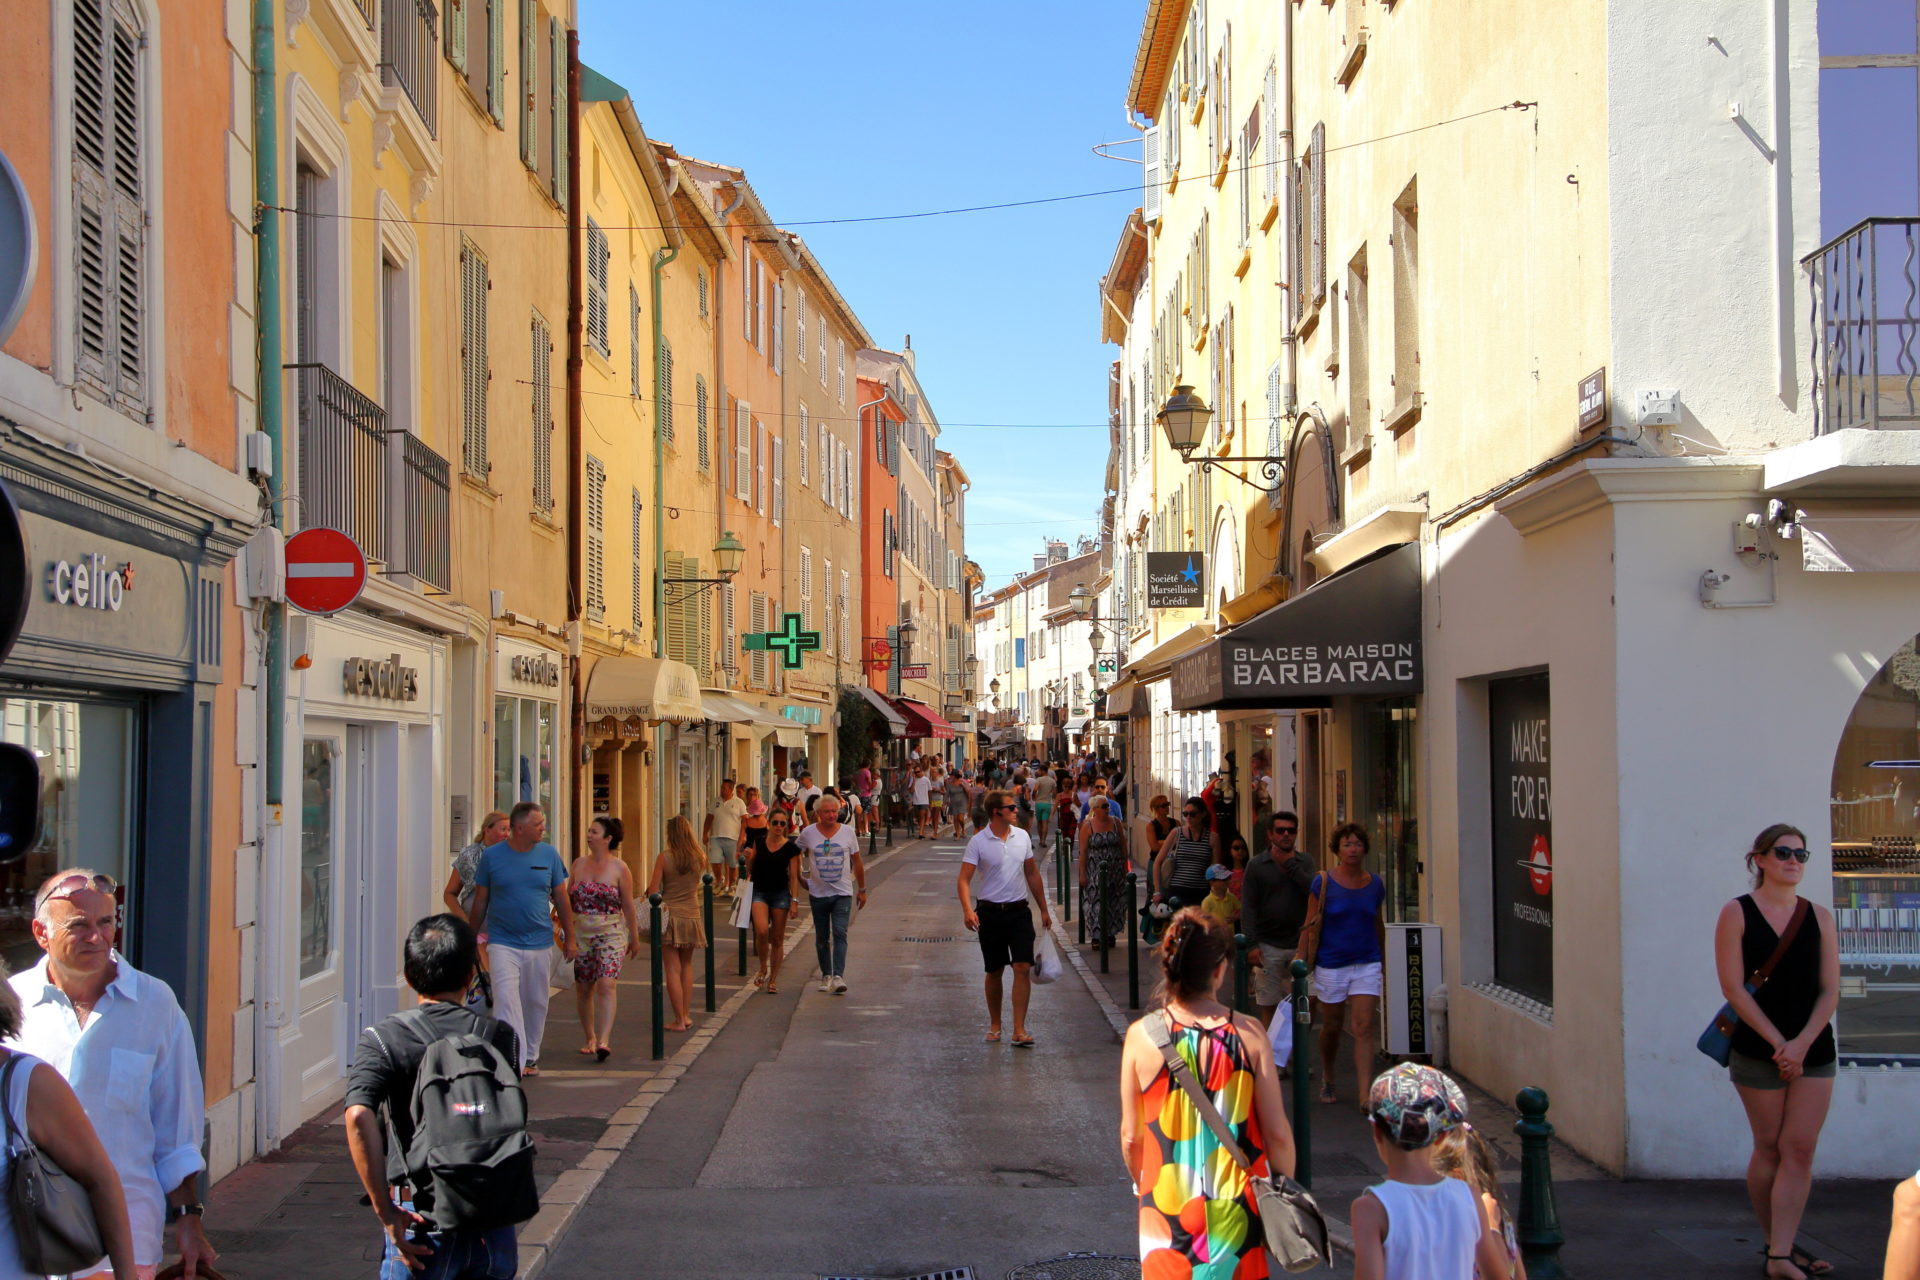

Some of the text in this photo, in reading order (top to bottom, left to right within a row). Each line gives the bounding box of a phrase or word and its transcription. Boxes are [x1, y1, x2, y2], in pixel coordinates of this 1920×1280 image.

[1584, 379, 1596, 398] RUE
[1149, 573, 1179, 583] Société
[1150, 584, 1199, 594] Marseillaise
[1150, 596, 1189, 606] de Crédit
[1234, 646, 1318, 662] GLACES
[1327, 643, 1413, 660] MAISON
[1233, 659, 1414, 685] BARBARAC
[591, 705, 650, 715] GRAND PASSAGE
[1511, 719, 1548, 763] MAKE
[1511, 775, 1535, 819] FOR
[1513, 902, 1552, 928] PROFESSIONAL
[1408, 954, 1423, 1042] BARBARAC
